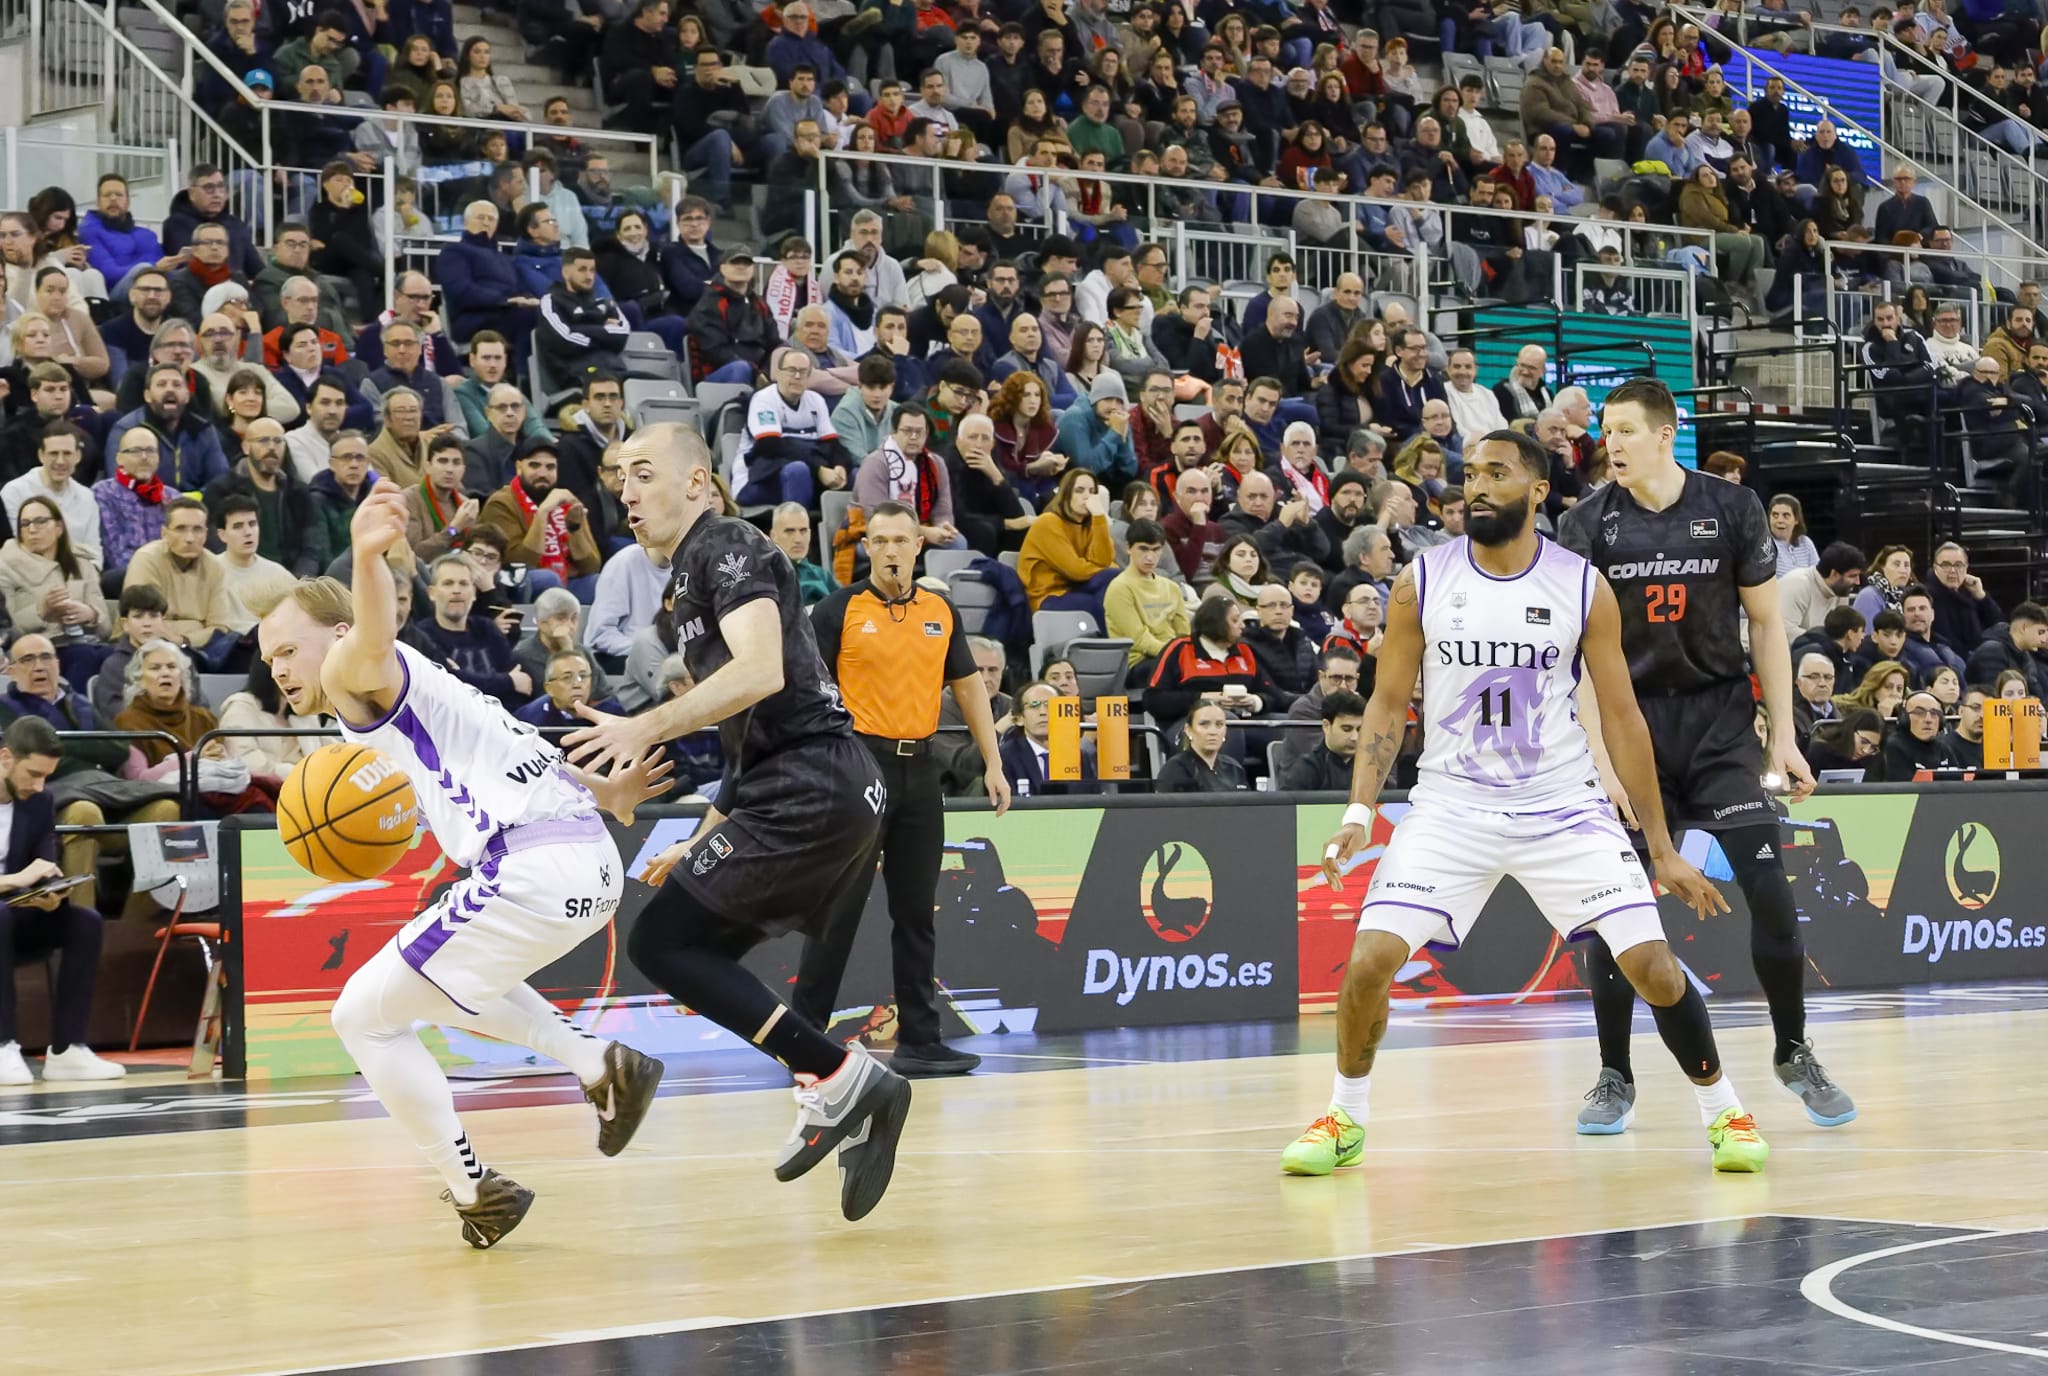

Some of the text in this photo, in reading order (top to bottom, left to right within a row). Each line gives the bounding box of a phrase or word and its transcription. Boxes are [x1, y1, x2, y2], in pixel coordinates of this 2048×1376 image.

[1645, 583, 1687, 622] 29
[1437, 640, 1560, 670] surne
[1478, 686, 1512, 727] 11
[1398, 882, 1433, 893] CORREO
[1581, 887, 1622, 905] NISSAN
[565, 898, 592, 918] SR
[1903, 914, 2046, 962] Dynos.es
[1083, 949, 1273, 1006] Dynos.es
